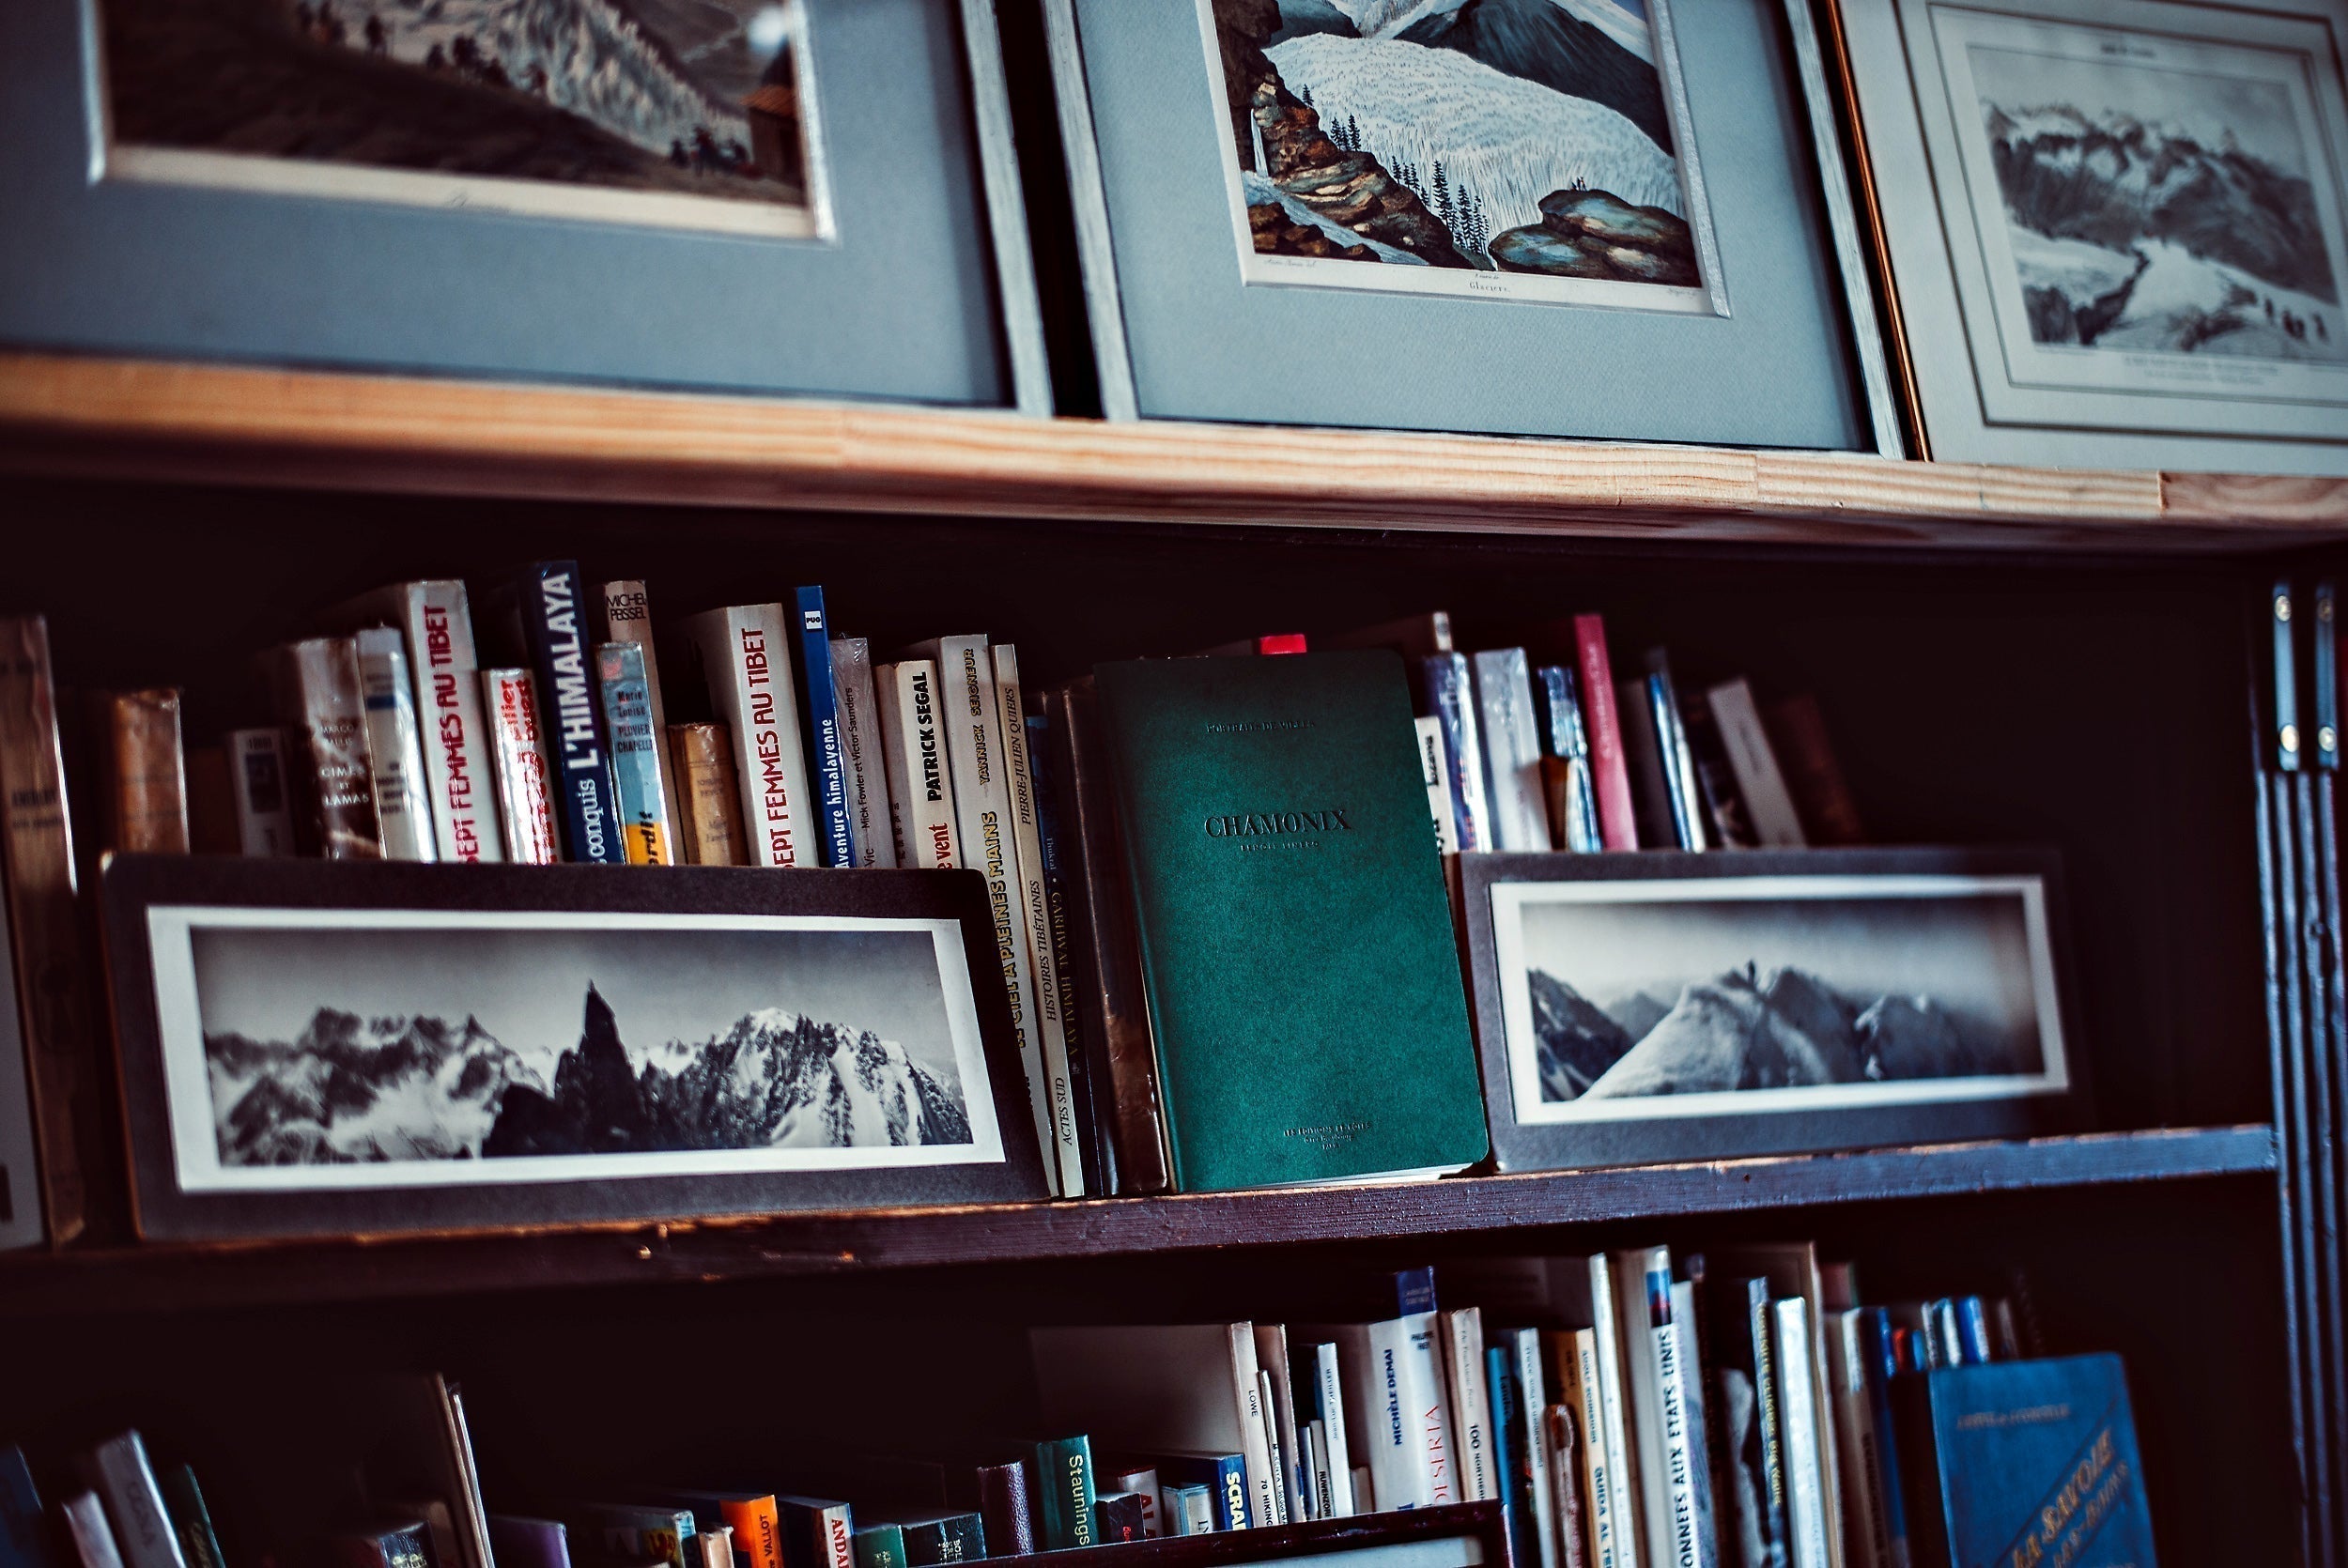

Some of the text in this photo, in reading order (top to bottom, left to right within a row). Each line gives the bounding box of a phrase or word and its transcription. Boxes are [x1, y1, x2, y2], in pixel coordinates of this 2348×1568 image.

[424, 605, 452, 667] TIBET
[806, 615, 822, 624] PUG
[433, 675, 459, 708] AU
[542, 571, 599, 770] L'HIMALAYA
[845, 687, 857, 732] Saunders
[911, 670, 943, 802] PATRICK SEGAL
[963, 648, 991, 786] YANNICK SEIGNEUR
[440, 715, 473, 811] FEMMES
[741, 627, 796, 869] EPT FEMMES AU TIBET
[822, 718, 842, 807] himalayenne
[851, 731, 862, 761] Victor
[1004, 687, 1031, 824] PIERRE-JULIEN QUIERS
[324, 793, 369, 806] LAMAS
[856, 772, 869, 805] Fowler
[577, 778, 607, 858] conquis
[858, 804, 871, 829] Mick
[928, 822, 952, 861] vent
[981, 810, 1005, 878] MAINS
[1204, 809, 1352, 838] CHAMONIX
[1029, 879, 1057, 1022] HISTOIRES TIBÉTAINES
[1051, 892, 1079, 1057] GARHWAL HIMALAYA
[1055, 1077, 1073, 1145] ACTES SUD
[1247, 1389, 1259, 1417] LOWE
[1469, 1424, 1481, 1450] 100
[1260, 1479, 1268, 1490] 70
[1669, 1445, 1685, 1485] AUX
[1069, 1454, 1090, 1546] Staunings
[1226, 1471, 1246, 1530] SCRA
[759, 1514, 772, 1557] VALLOT
[830, 1517, 849, 1568] ANDA
